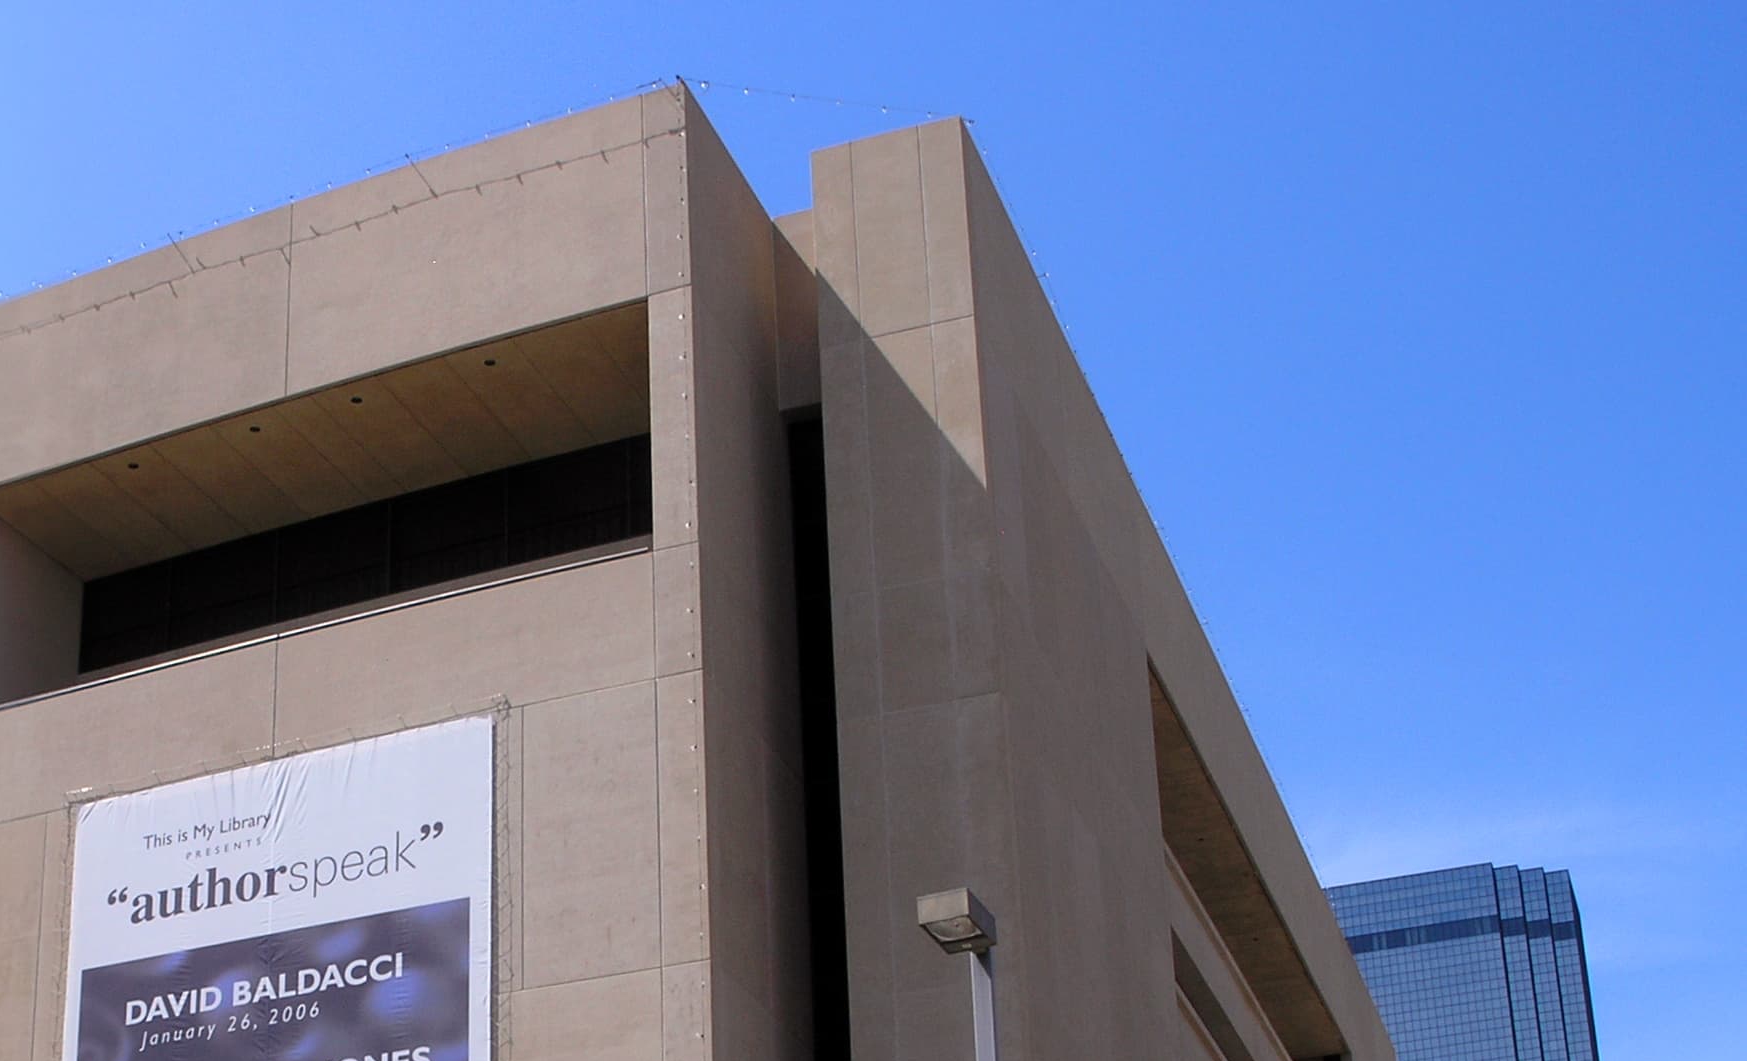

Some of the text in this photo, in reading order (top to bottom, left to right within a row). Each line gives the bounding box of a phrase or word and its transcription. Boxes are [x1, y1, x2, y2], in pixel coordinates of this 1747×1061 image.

[144, 812, 271, 850] This is My Library
[186, 837, 262, 860] PRESENTS
[125, 952, 403, 1026] DAVID BALDACCI
[140, 1001, 320, 1051] January 26, 2006
